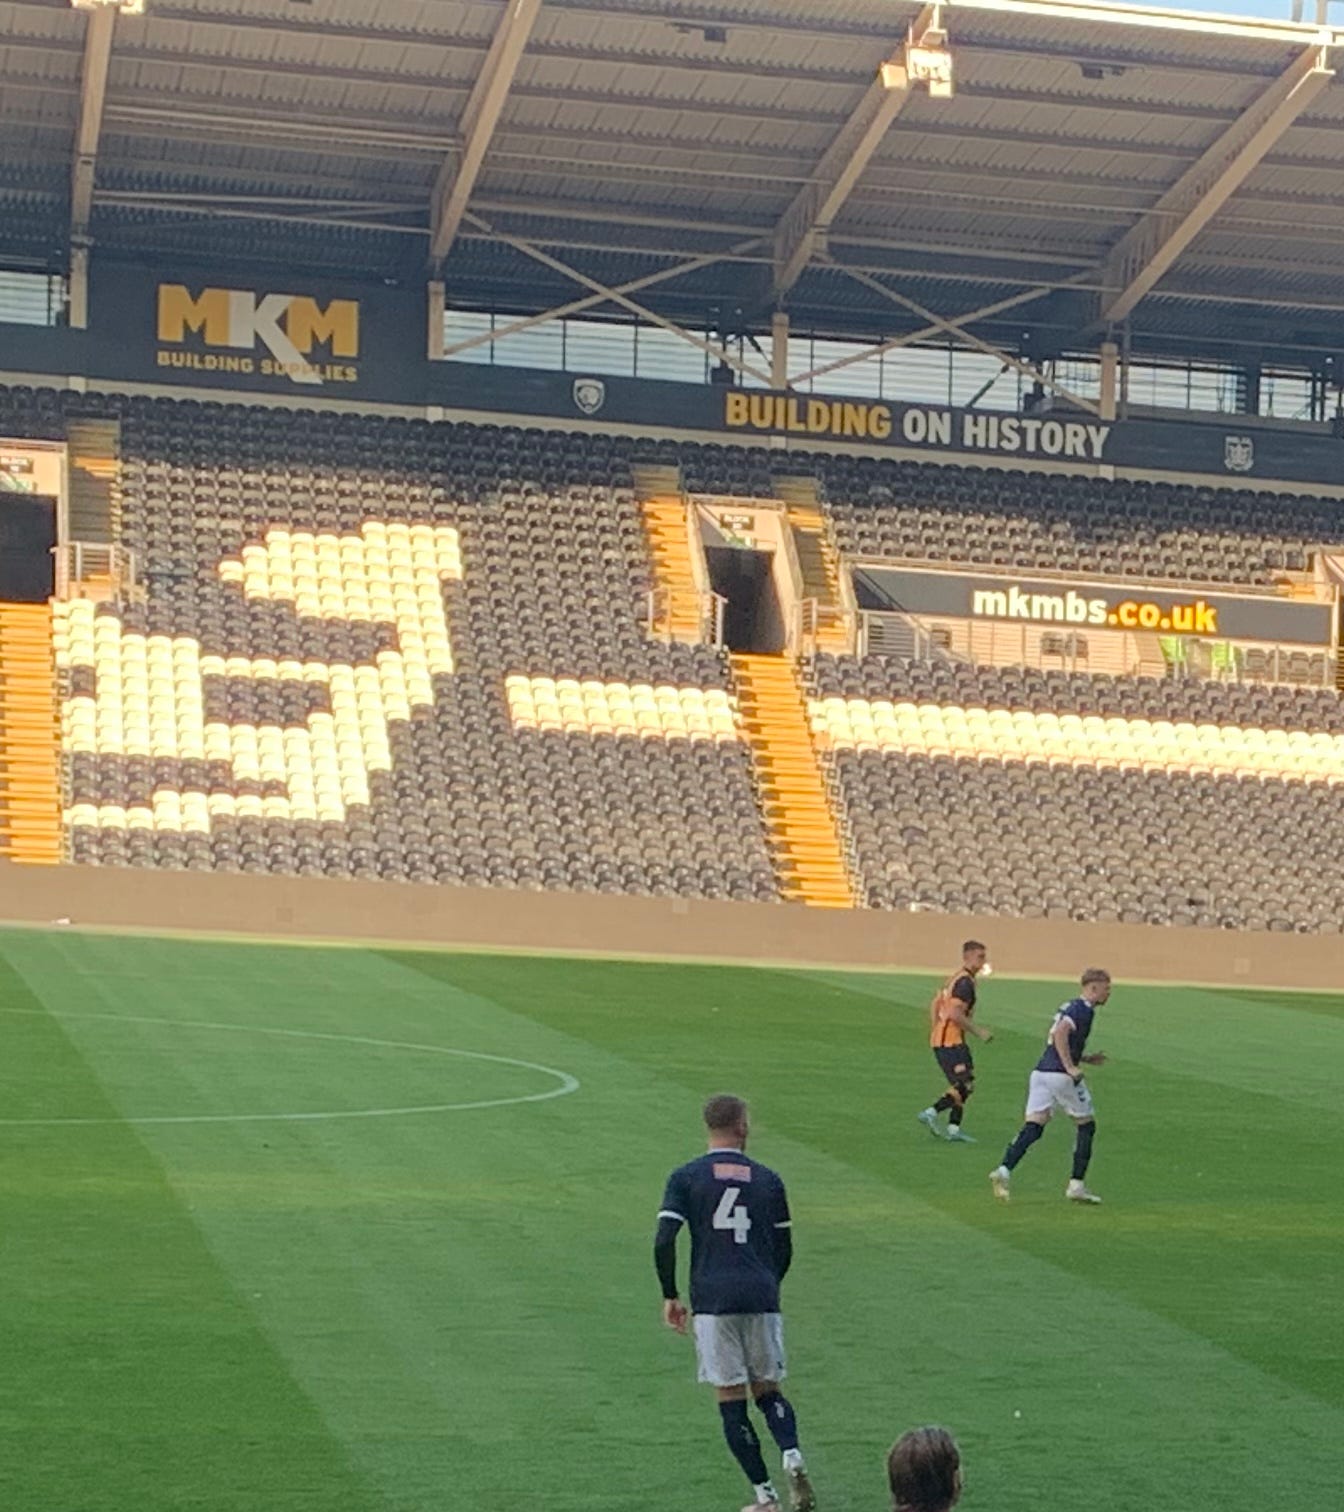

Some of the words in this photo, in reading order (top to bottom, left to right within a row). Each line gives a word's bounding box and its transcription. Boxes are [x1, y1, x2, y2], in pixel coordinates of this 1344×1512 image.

[157, 284, 359, 384] MKM
[157, 350, 254, 373] BUILDING
[726, 393, 890, 438] BUILDING
[903, 408, 950, 443] ON
[962, 414, 1110, 458] HISTORY
[973, 585, 1217, 633] mkmbs.co.uk
[713, 1187, 751, 1243] 4
